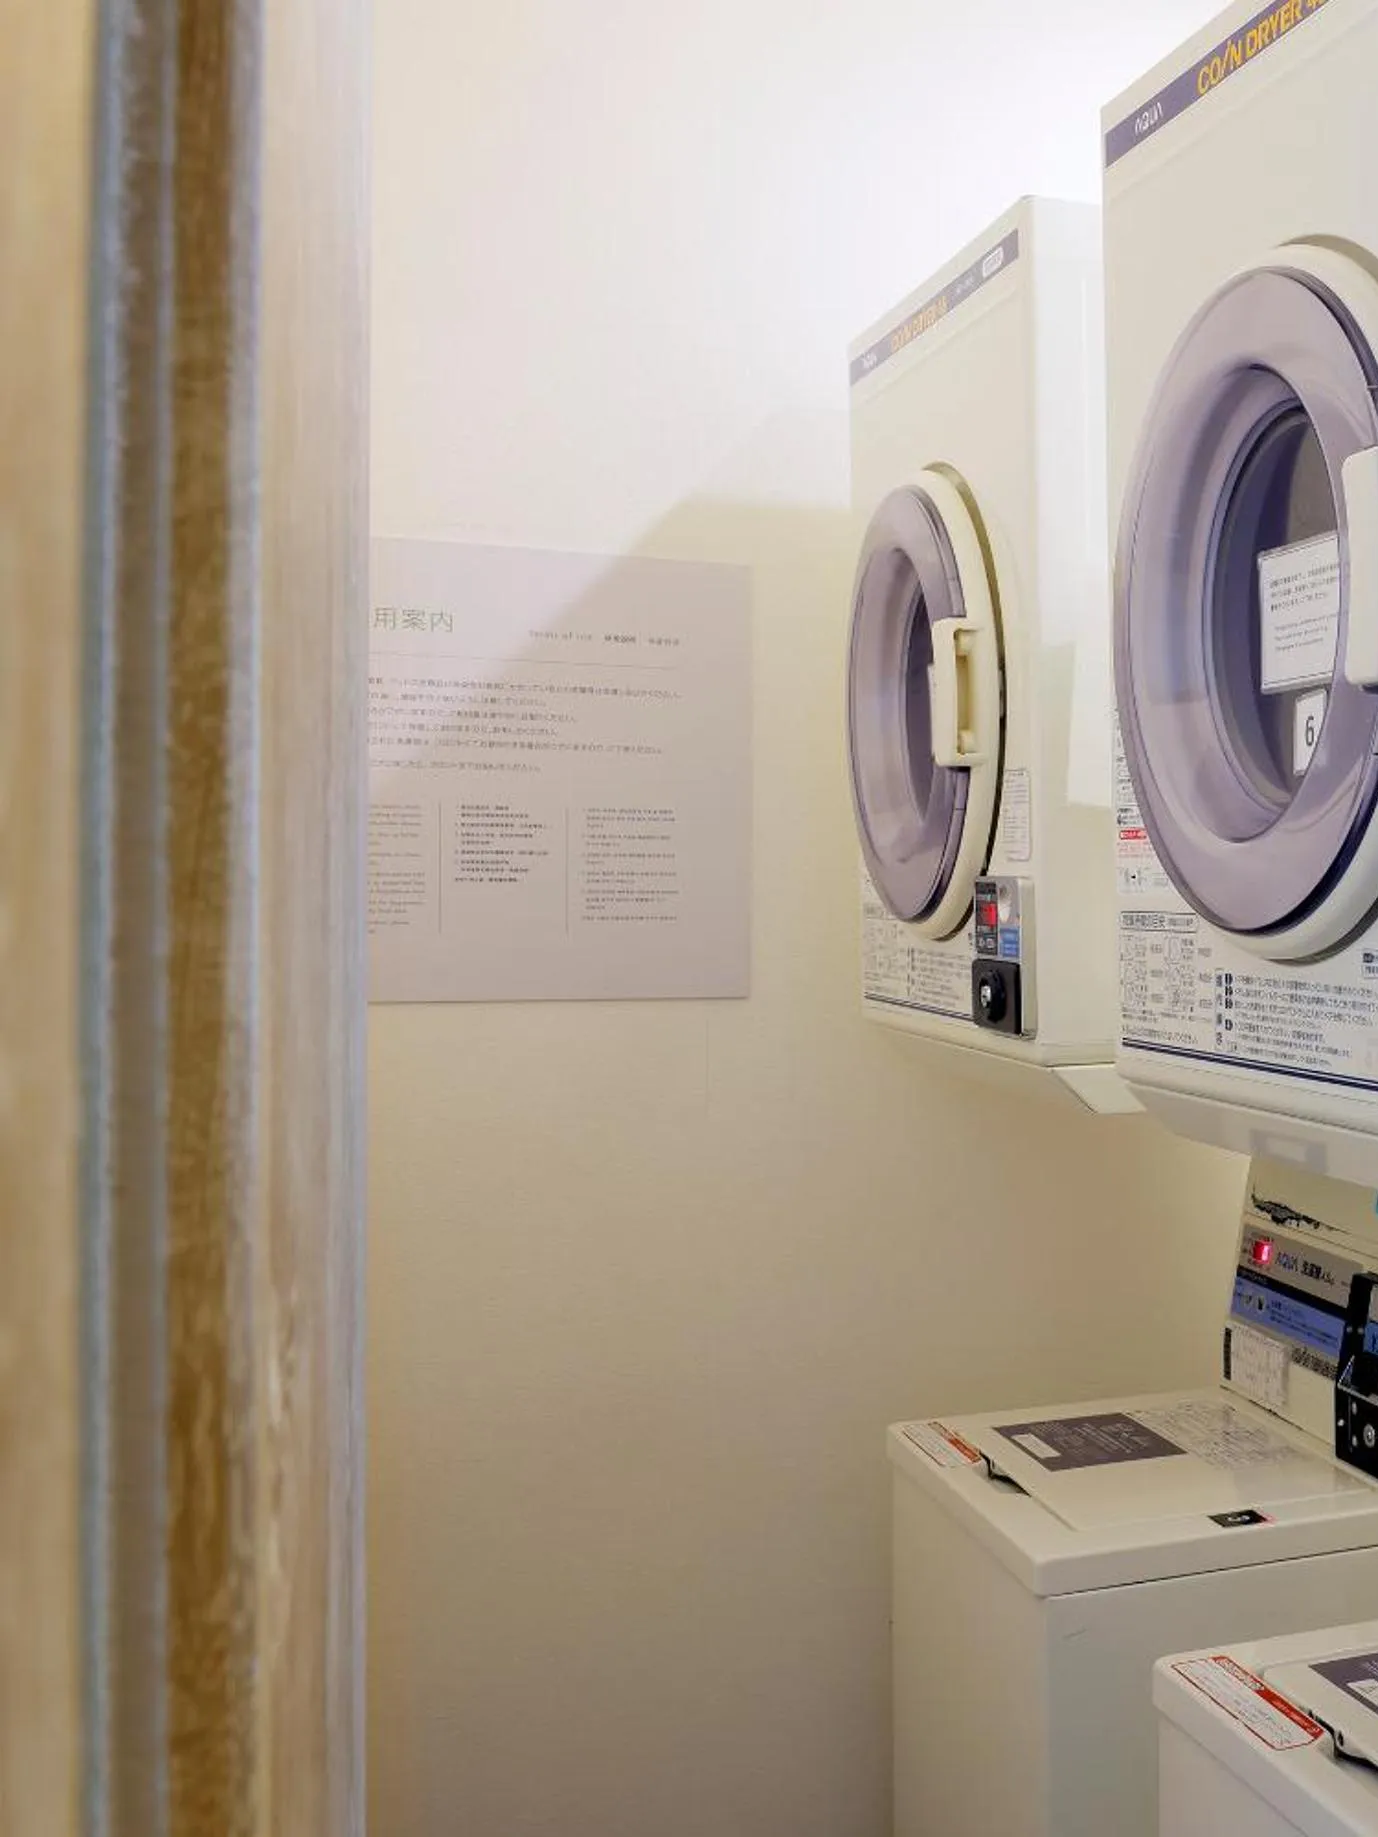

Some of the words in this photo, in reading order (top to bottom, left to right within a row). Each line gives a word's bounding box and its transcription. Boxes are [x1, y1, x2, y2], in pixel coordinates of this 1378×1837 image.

[1245, 0, 1303, 58] DRYER
[373, 606, 454, 634] 用案内
[1304, 715, 1316, 747] 6
